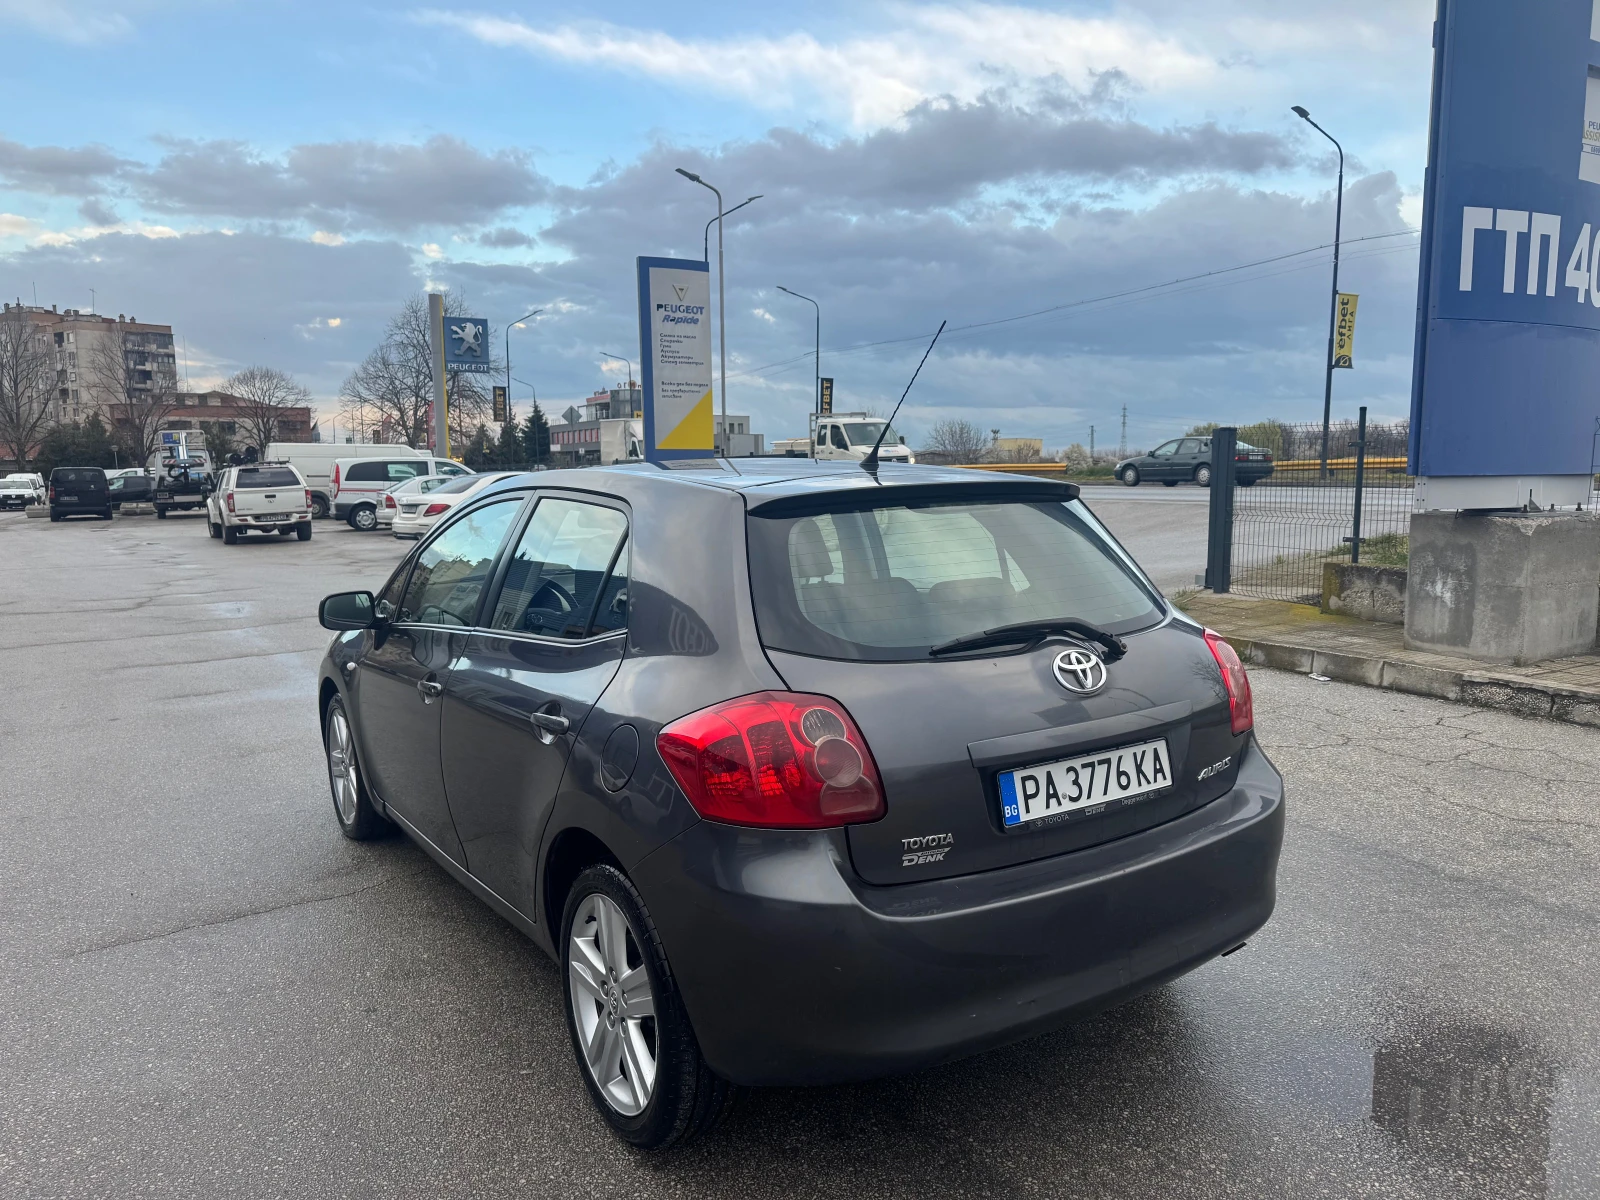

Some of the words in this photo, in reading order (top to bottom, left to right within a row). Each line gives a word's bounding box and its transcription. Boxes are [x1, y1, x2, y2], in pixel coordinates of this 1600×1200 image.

[1459, 206, 1561, 297] ГТП
[656, 304, 704, 315] PEUGEOT
[662, 314, 700, 324] Rapide
[1338, 297, 1350, 350] efbet
[447, 363, 489, 371] PEUGEOT
[823, 380, 831, 415] EFBET
[1197, 756, 1232, 782] AURIS
[1005, 805, 1018, 818] BG
[1044, 813, 1070, 825] TOYOTA
[901, 833, 955, 850] TOYOTA
[902, 852, 946, 867] DENK
